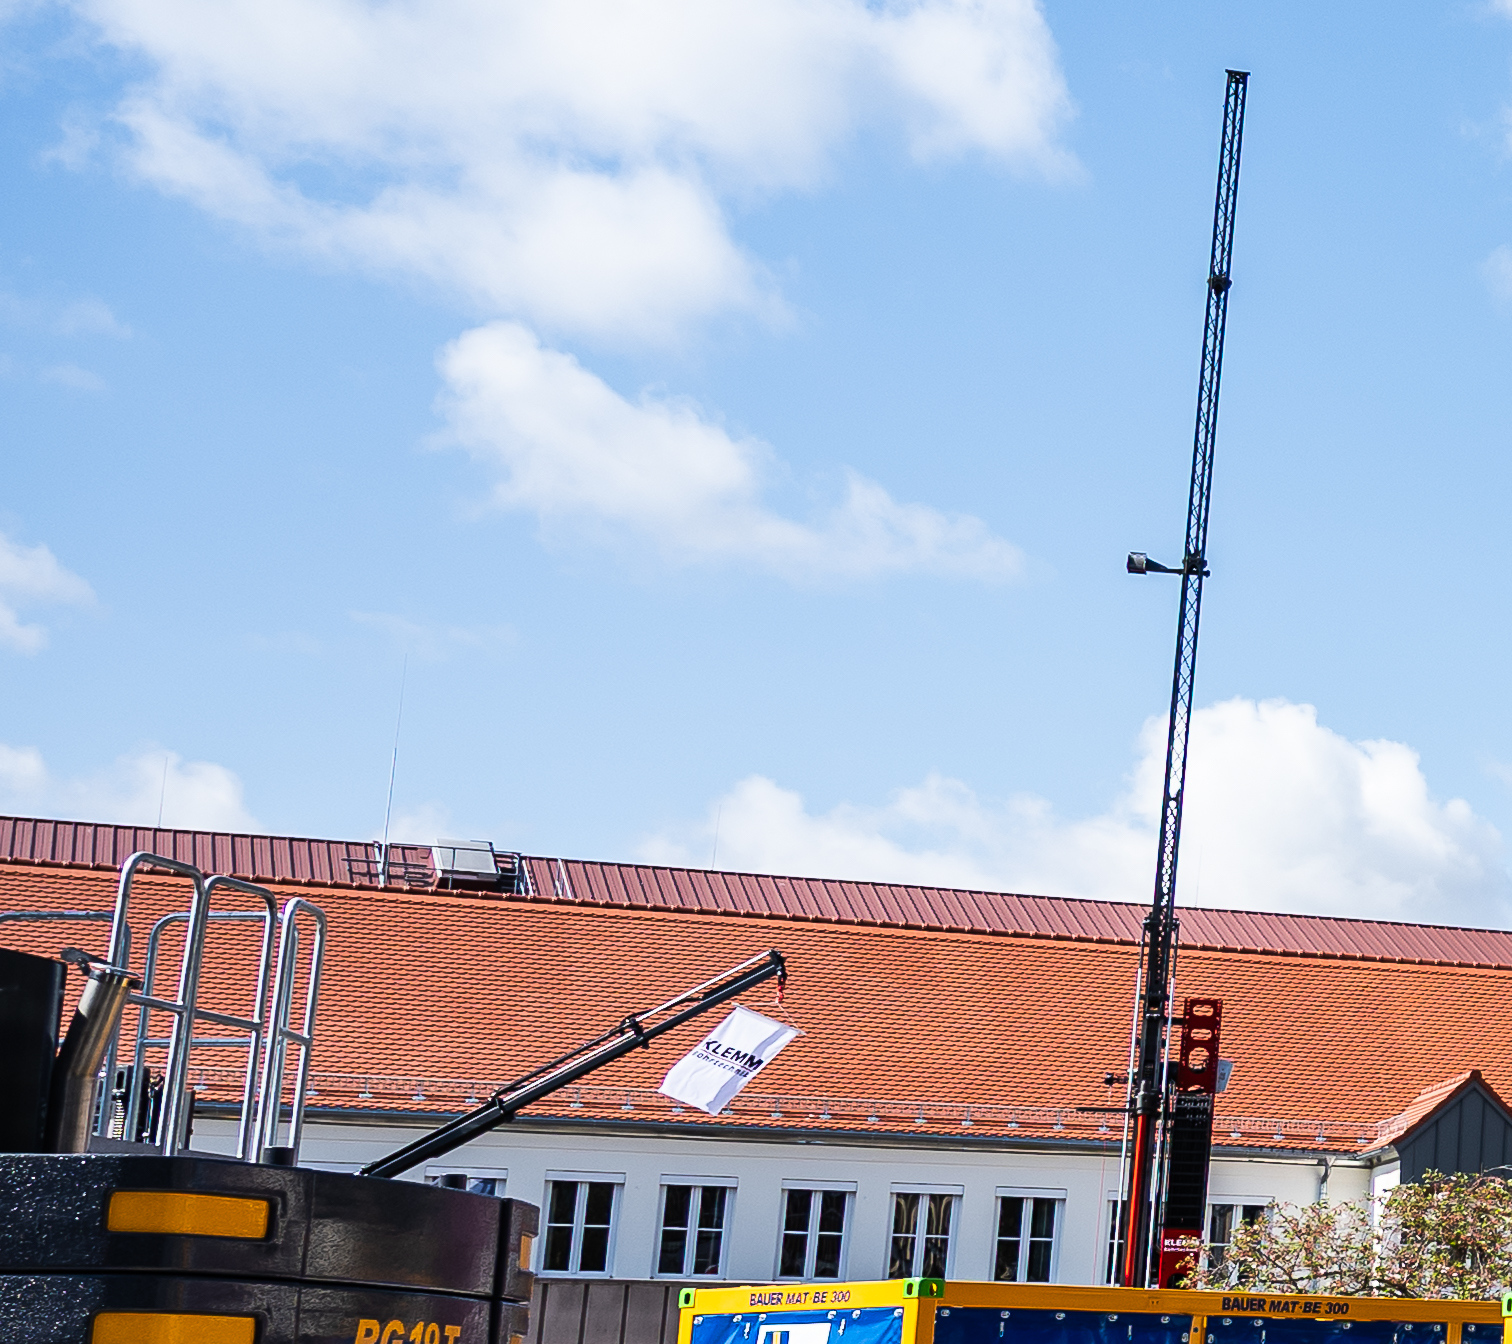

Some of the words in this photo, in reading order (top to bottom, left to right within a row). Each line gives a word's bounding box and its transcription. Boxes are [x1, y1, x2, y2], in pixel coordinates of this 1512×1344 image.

[705, 1041, 764, 1070] KLEMM
[749, 1292, 783, 1306] BAUER
[831, 1290, 850, 1302] 300
[1222, 1297, 1266, 1311] BAUER
[1325, 1302, 1349, 1314] 300
